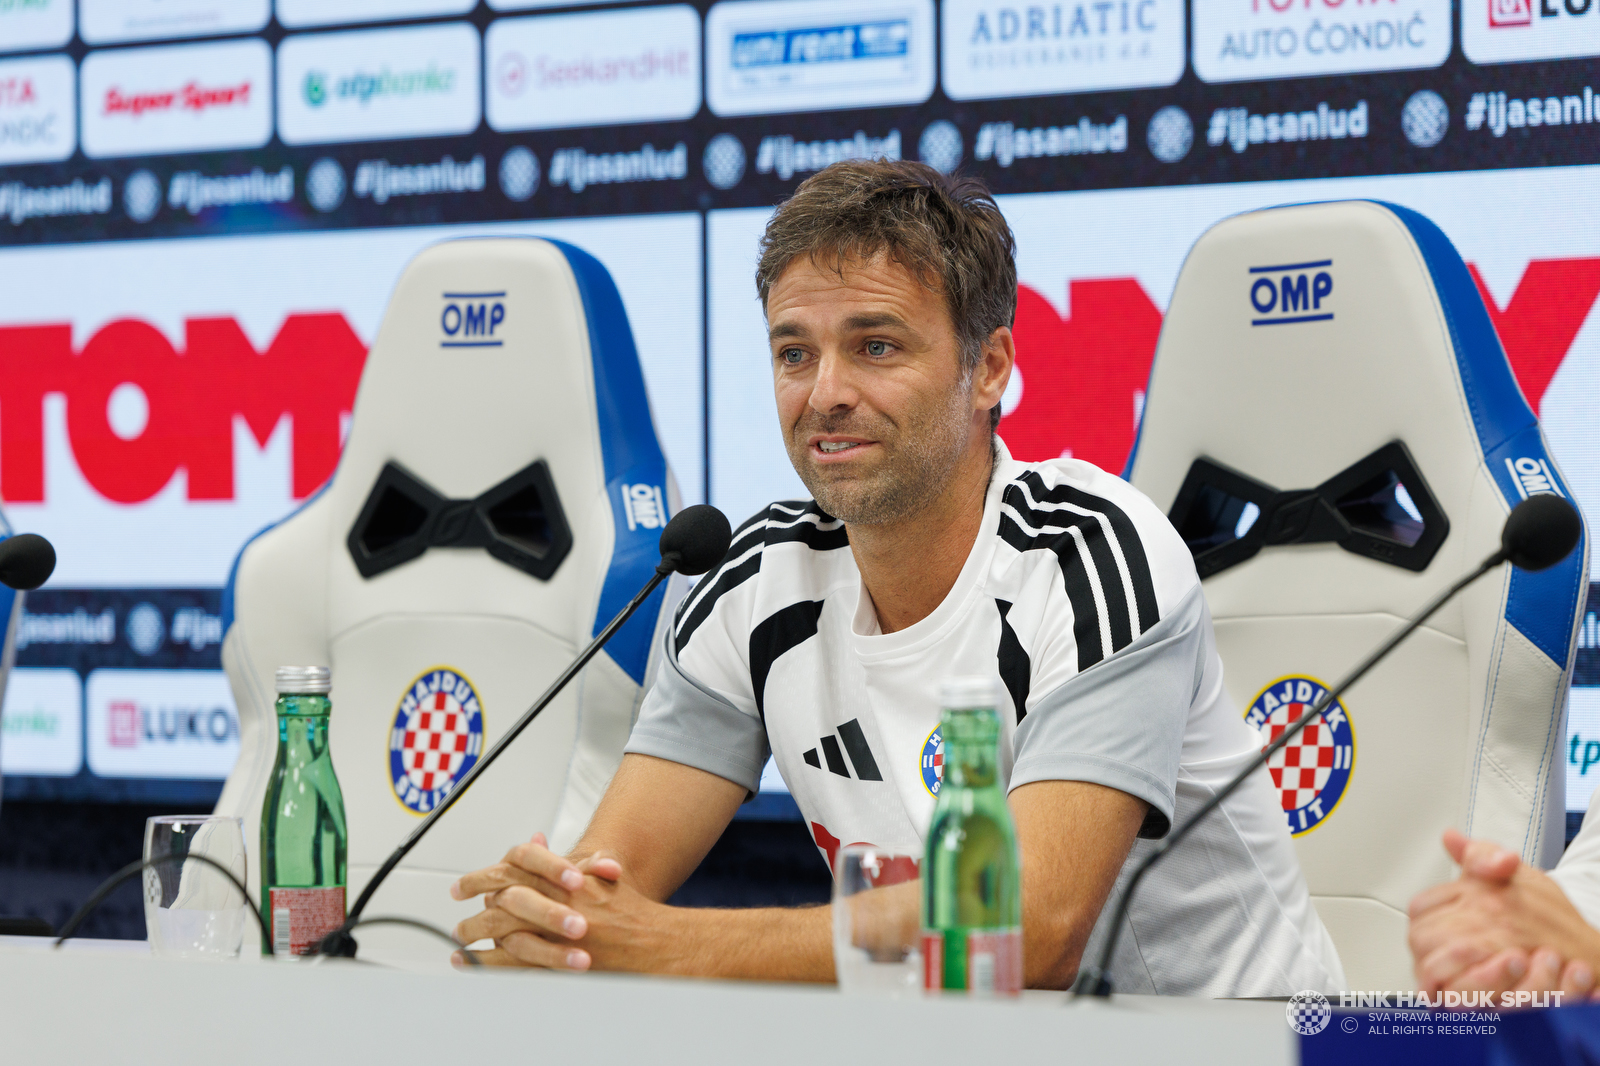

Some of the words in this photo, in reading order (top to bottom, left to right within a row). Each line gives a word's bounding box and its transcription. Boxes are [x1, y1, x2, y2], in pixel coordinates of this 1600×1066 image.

[969, 0, 1156, 46] ADRIATIC
[1219, 26, 1299, 62] AUTO
[1305, 9, 1425, 55] ČONDIĆ
[975, 114, 1128, 168] #ijasanlud
[1206, 99, 1369, 153] #ijasanlud
[168, 165, 294, 216] #ijasanlud
[353, 153, 486, 205] #ijasanlud
[549, 141, 688, 193] #ijasanlud
[1250, 271, 1332, 314] OMP
[442, 303, 505, 336] OMP
[1515, 457, 1556, 496] OM
[630, 483, 660, 529] OMP
[400, 671, 480, 721] HAJDUK
[1246, 680, 1347, 733] HAJDUK
